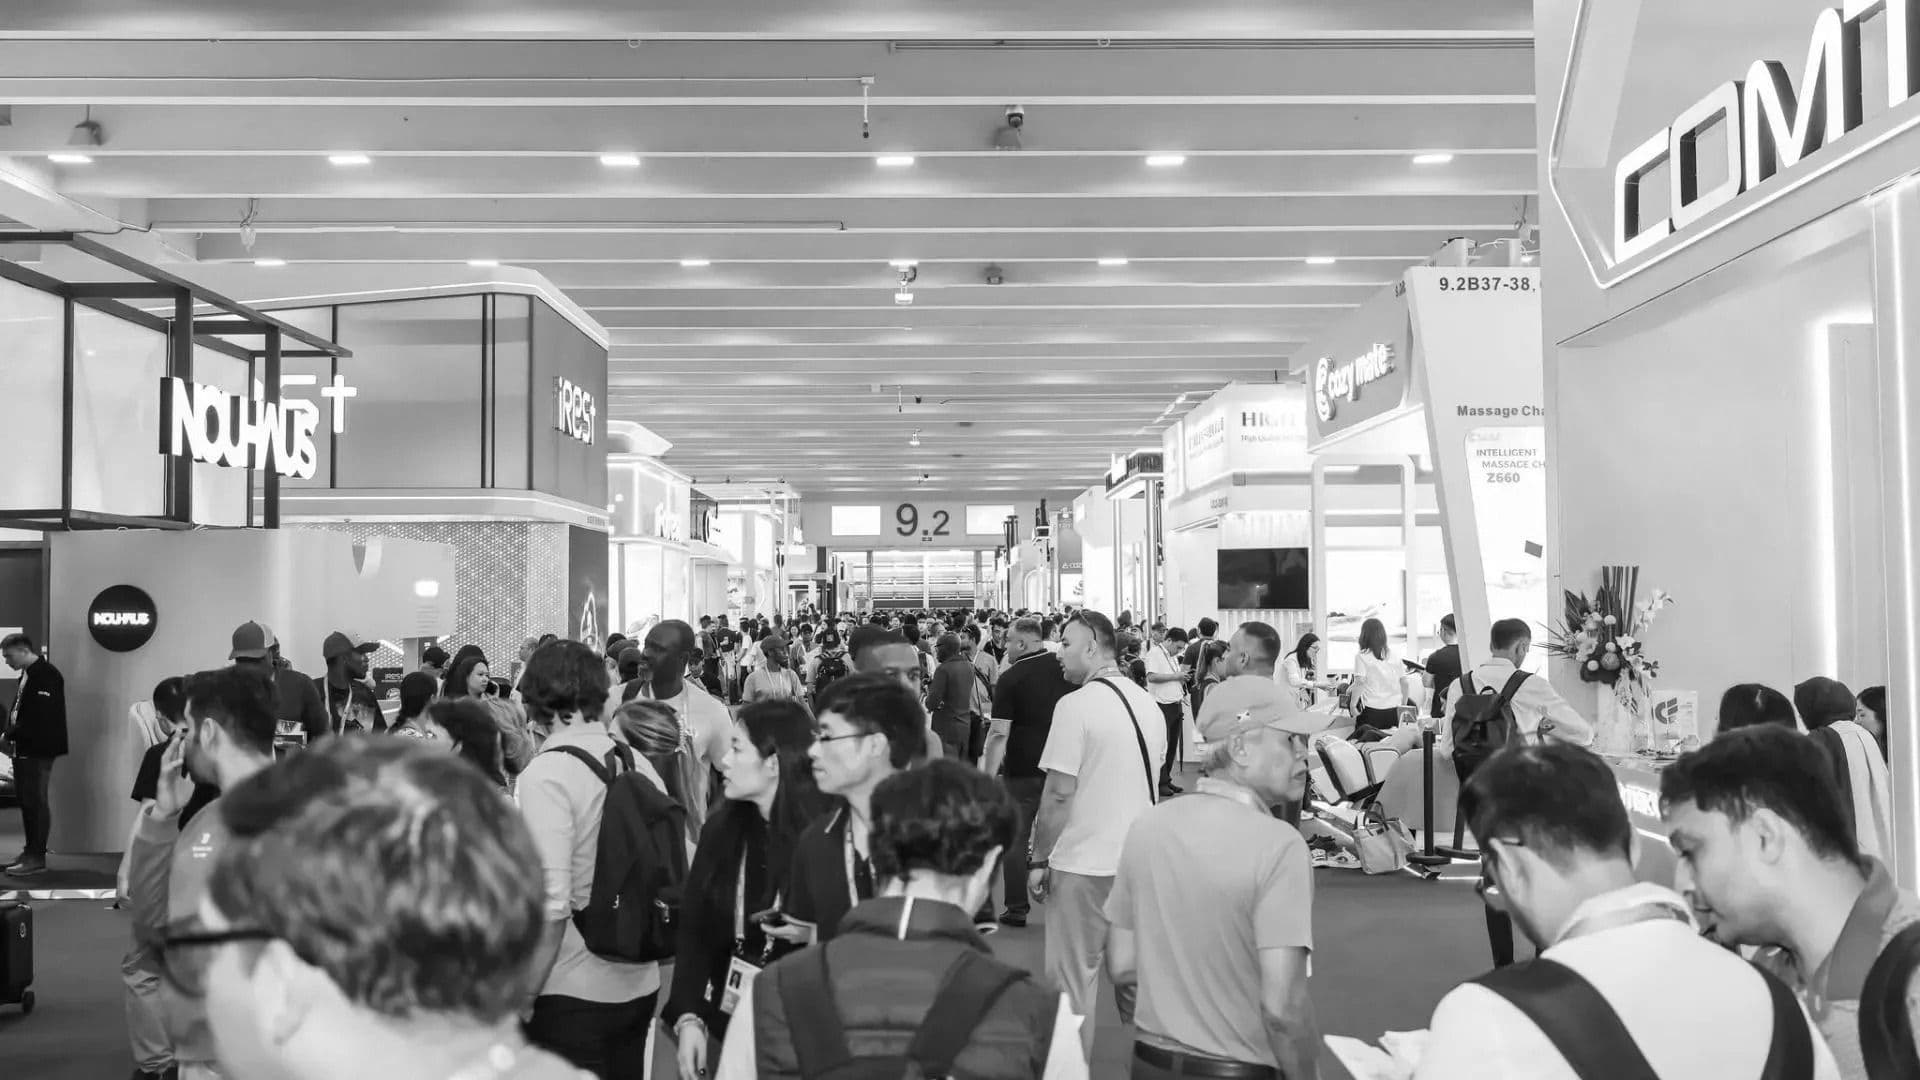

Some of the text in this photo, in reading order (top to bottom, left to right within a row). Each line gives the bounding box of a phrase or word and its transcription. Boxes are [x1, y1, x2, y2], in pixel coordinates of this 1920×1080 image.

[1614, 0, 1911, 265] COMT
[1327, 343, 1389, 403] cozy mate
[1456, 404, 1519, 418] Massage
[1476, 448, 1537, 457] INTELLIGENT
[1482, 460, 1529, 469] MASSAGE
[895, 503, 951, 537] 9.2
